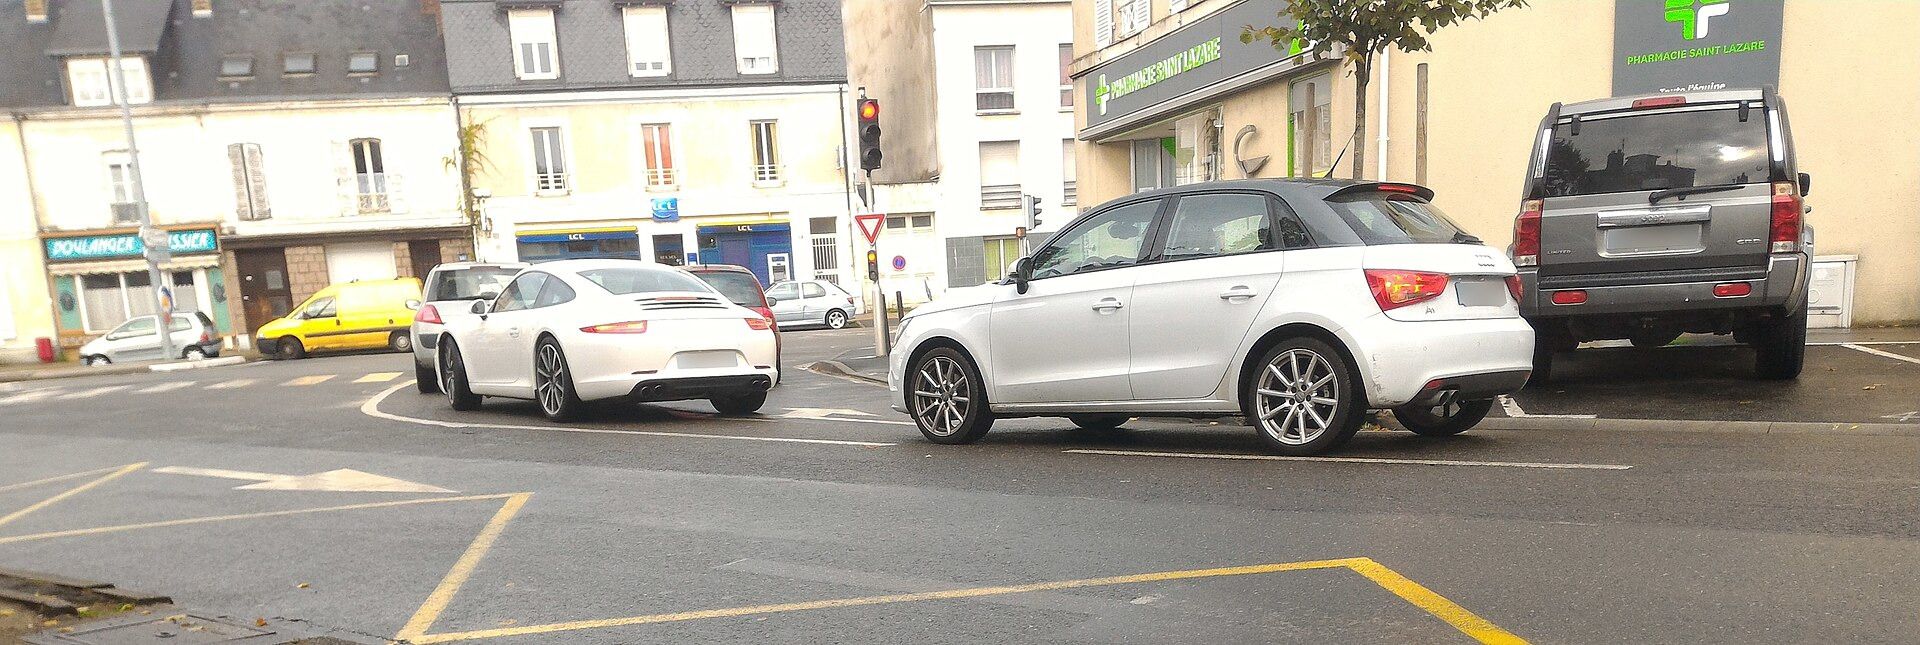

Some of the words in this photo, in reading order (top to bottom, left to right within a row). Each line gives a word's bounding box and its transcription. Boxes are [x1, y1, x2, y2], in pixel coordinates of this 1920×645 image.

[1627, 51, 1687, 65] PHARMACIE
[1689, 46, 1720, 58] SAINT
[1723, 40, 1766, 54] LAZARE
[1110, 63, 1156, 99] PHARMACIE
[1156, 52, 1182, 82] SAINT
[1183, 36, 1221, 72] LAZARE
[652, 201, 676, 210] LCL
[53, 236, 135, 256] BOULANGER
[168, 231, 209, 250] ISSIER
